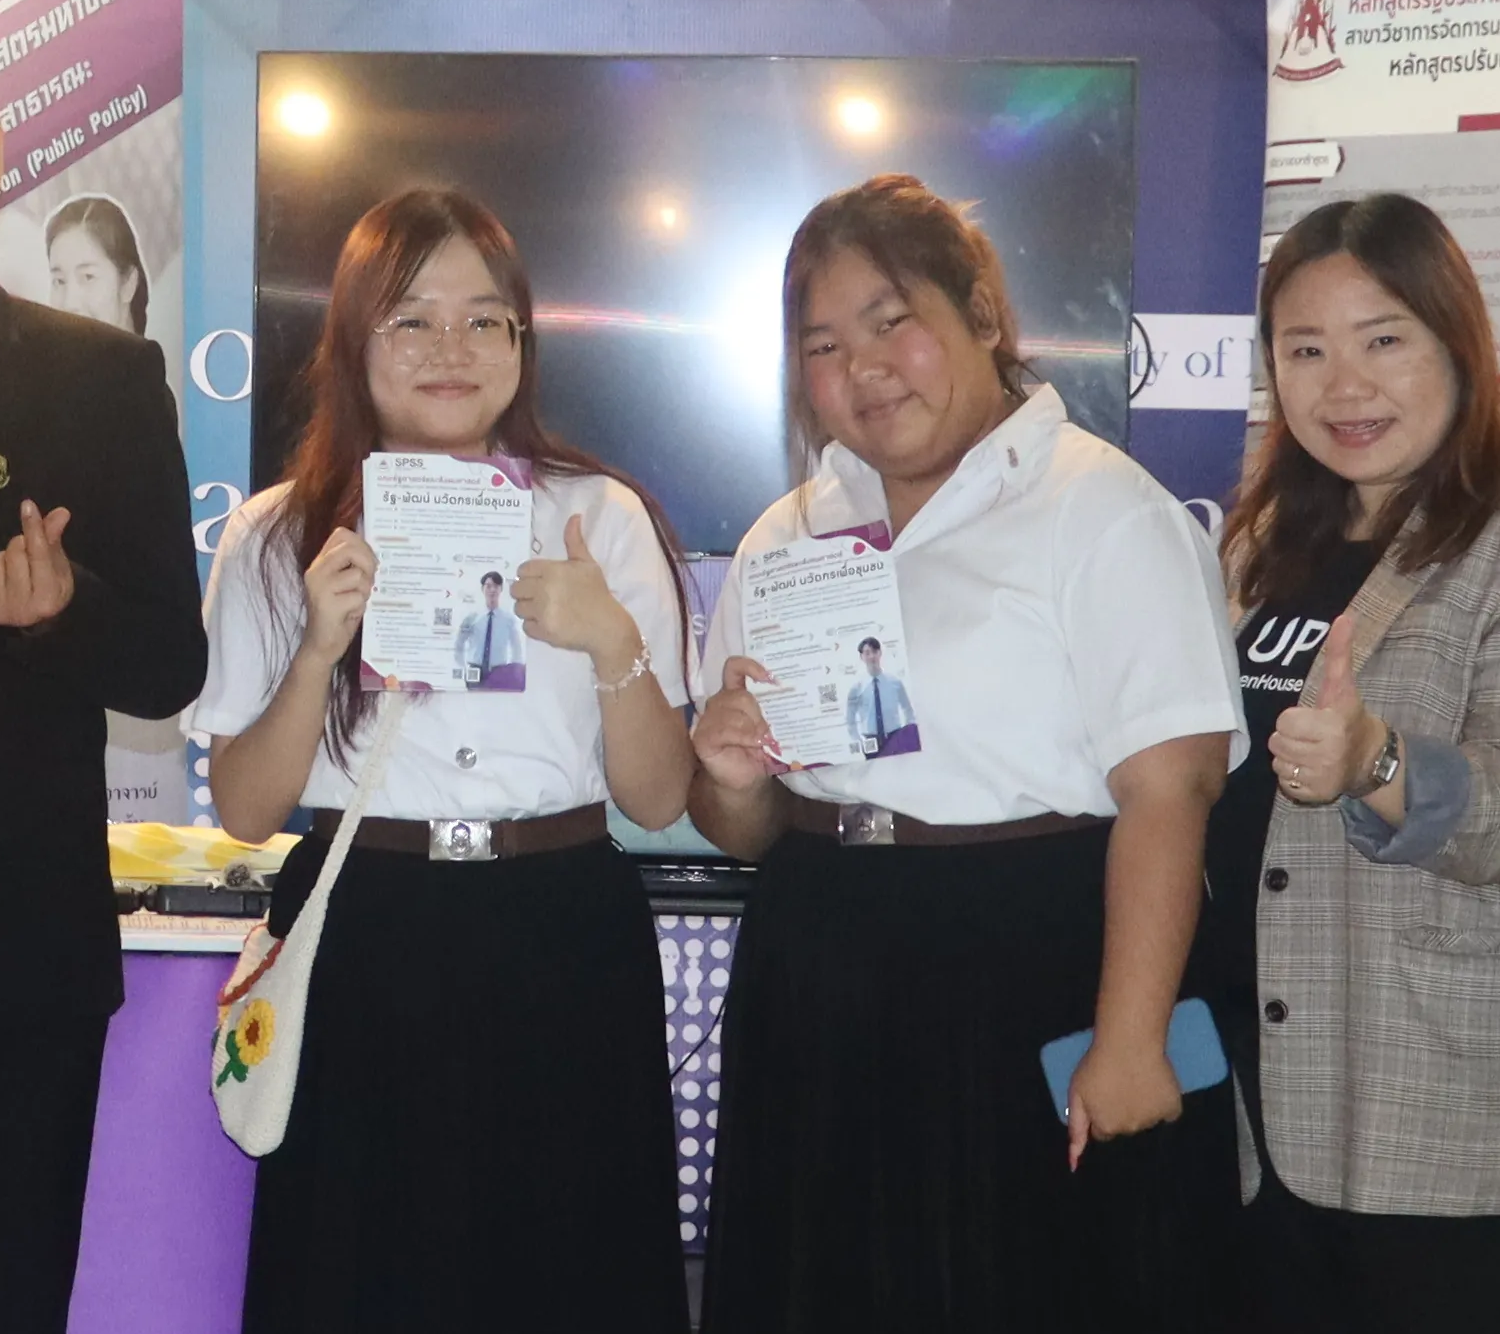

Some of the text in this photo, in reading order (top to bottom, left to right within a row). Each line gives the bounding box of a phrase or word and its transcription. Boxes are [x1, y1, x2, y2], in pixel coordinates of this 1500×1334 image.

[28, 127, 86, 180] (Public
[91, 83, 148, 136] Policy)
[1184, 336, 1235, 378] of
[394, 457, 424, 468] SPSS
[763, 547, 789, 563] SPSS
[1247, 615, 1331, 667] UP
